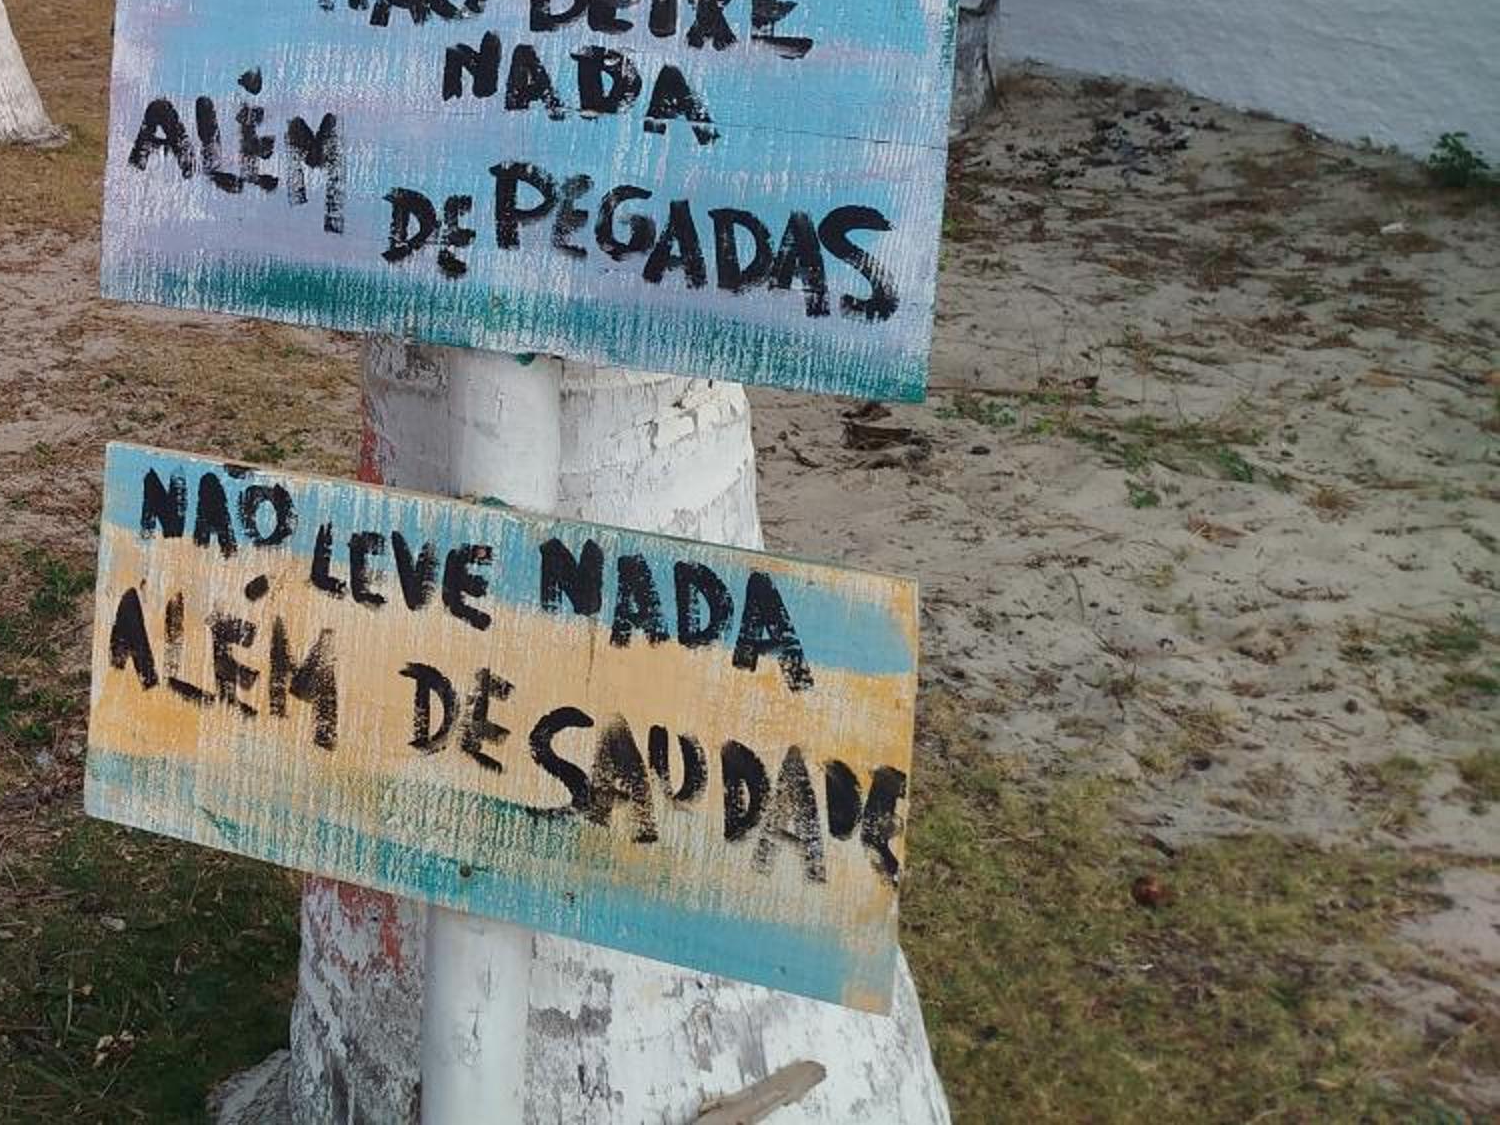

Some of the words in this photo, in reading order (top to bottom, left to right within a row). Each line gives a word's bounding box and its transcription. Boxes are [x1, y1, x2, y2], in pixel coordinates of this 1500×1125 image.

[442, 31, 720, 144] NADA
[128, 69, 344, 234] ALÉM
[381, 186, 475, 276] DE
[490, 161, 899, 322] PEGADAS
[109, 574, 338, 751] ALÉM
[400, 661, 514, 774] DE
[311, 523, 493, 631] LEVE
[540, 537, 815, 692] NADA
